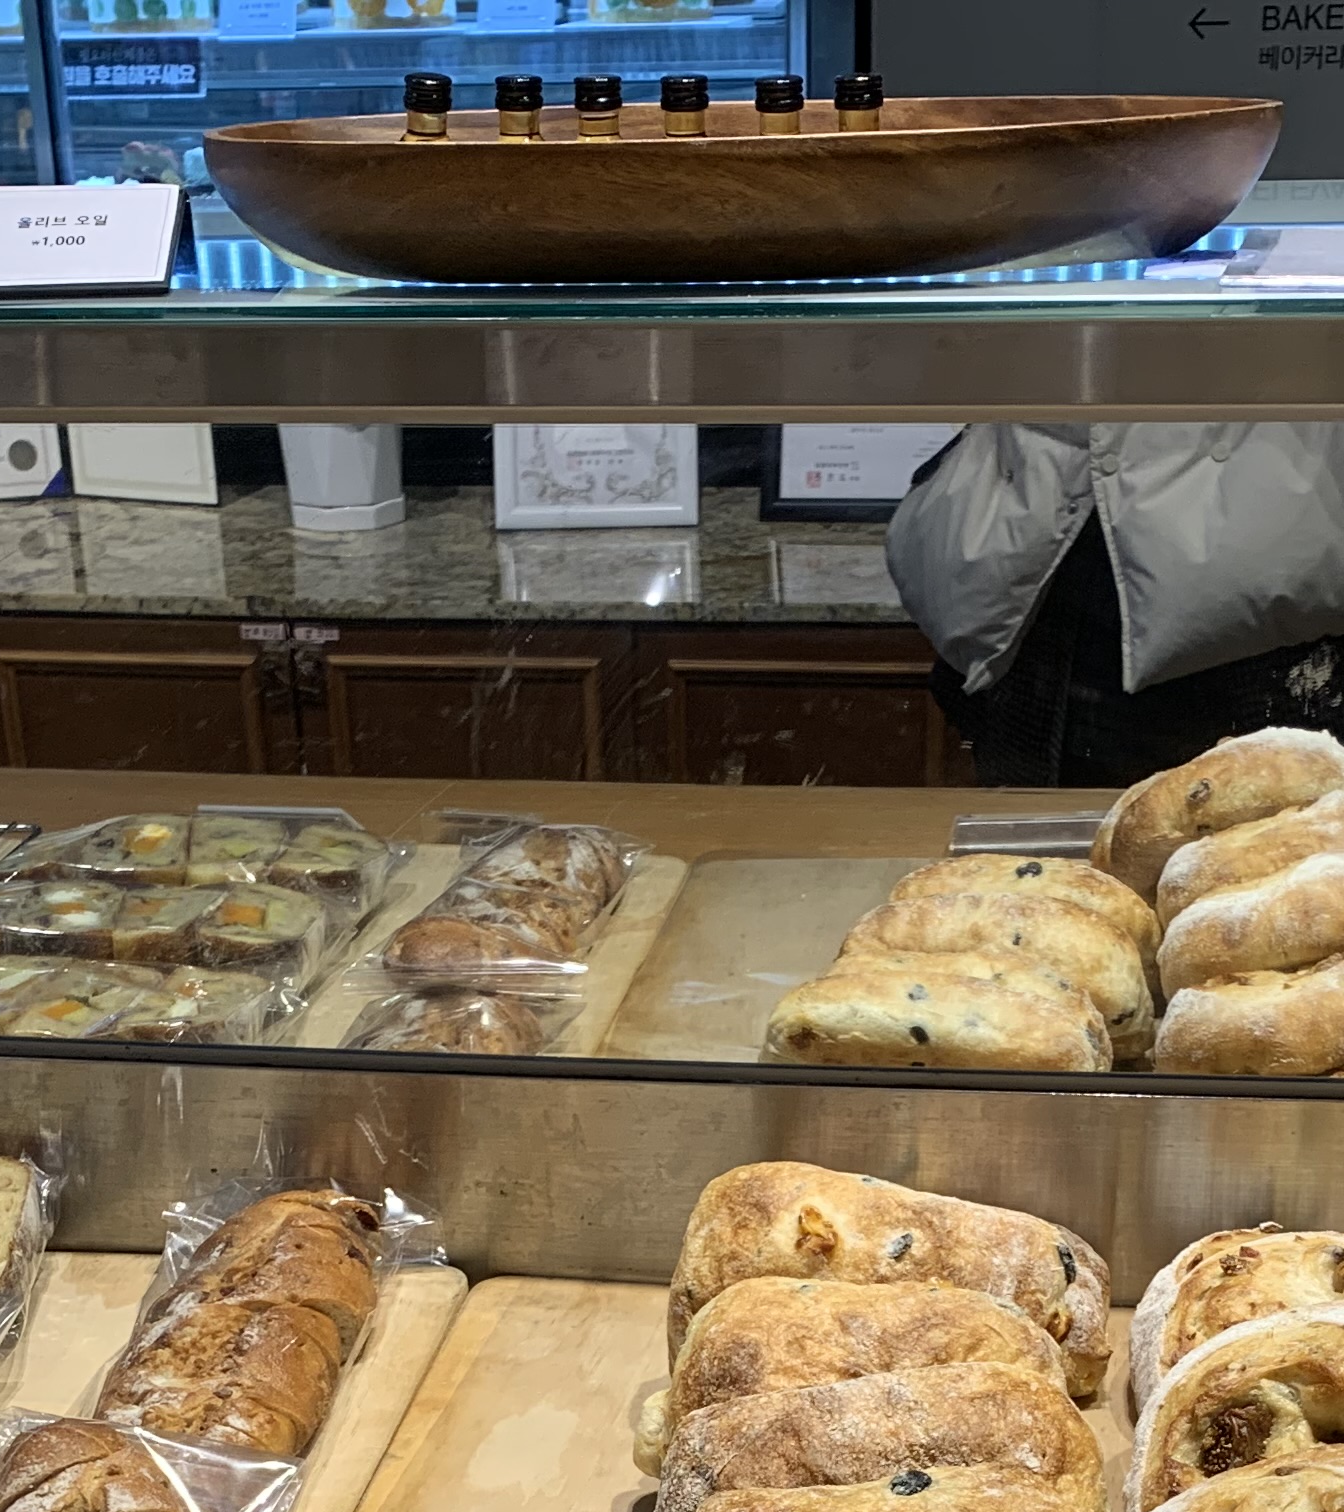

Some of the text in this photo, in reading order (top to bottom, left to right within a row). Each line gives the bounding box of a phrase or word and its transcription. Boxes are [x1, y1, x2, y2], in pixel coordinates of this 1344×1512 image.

[1258, 44, 1344, 71] 베이커리
[17, 214, 109, 229] 올리브 오일
[31, 235, 86, 247] ₩1,000
